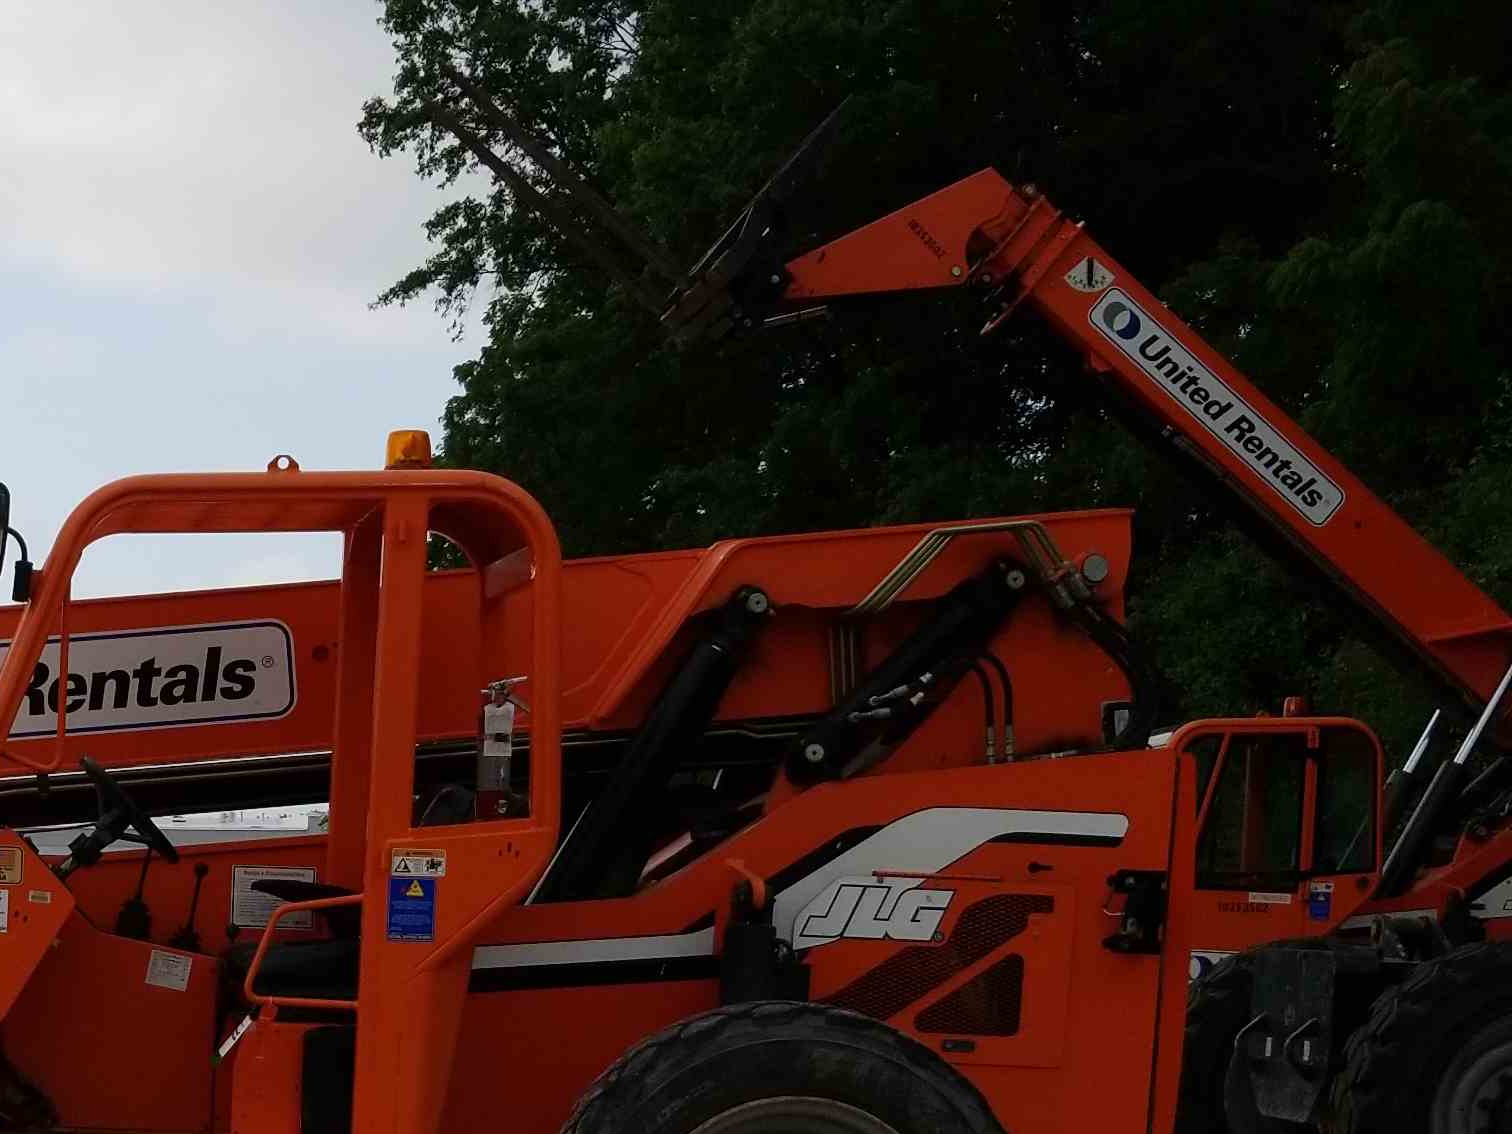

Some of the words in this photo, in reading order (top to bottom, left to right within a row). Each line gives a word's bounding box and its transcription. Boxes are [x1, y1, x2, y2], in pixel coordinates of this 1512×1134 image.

[1139, 334, 1234, 421] United
[1224, 414, 1324, 508] Rentals
[799, 884, 956, 942] JLG
